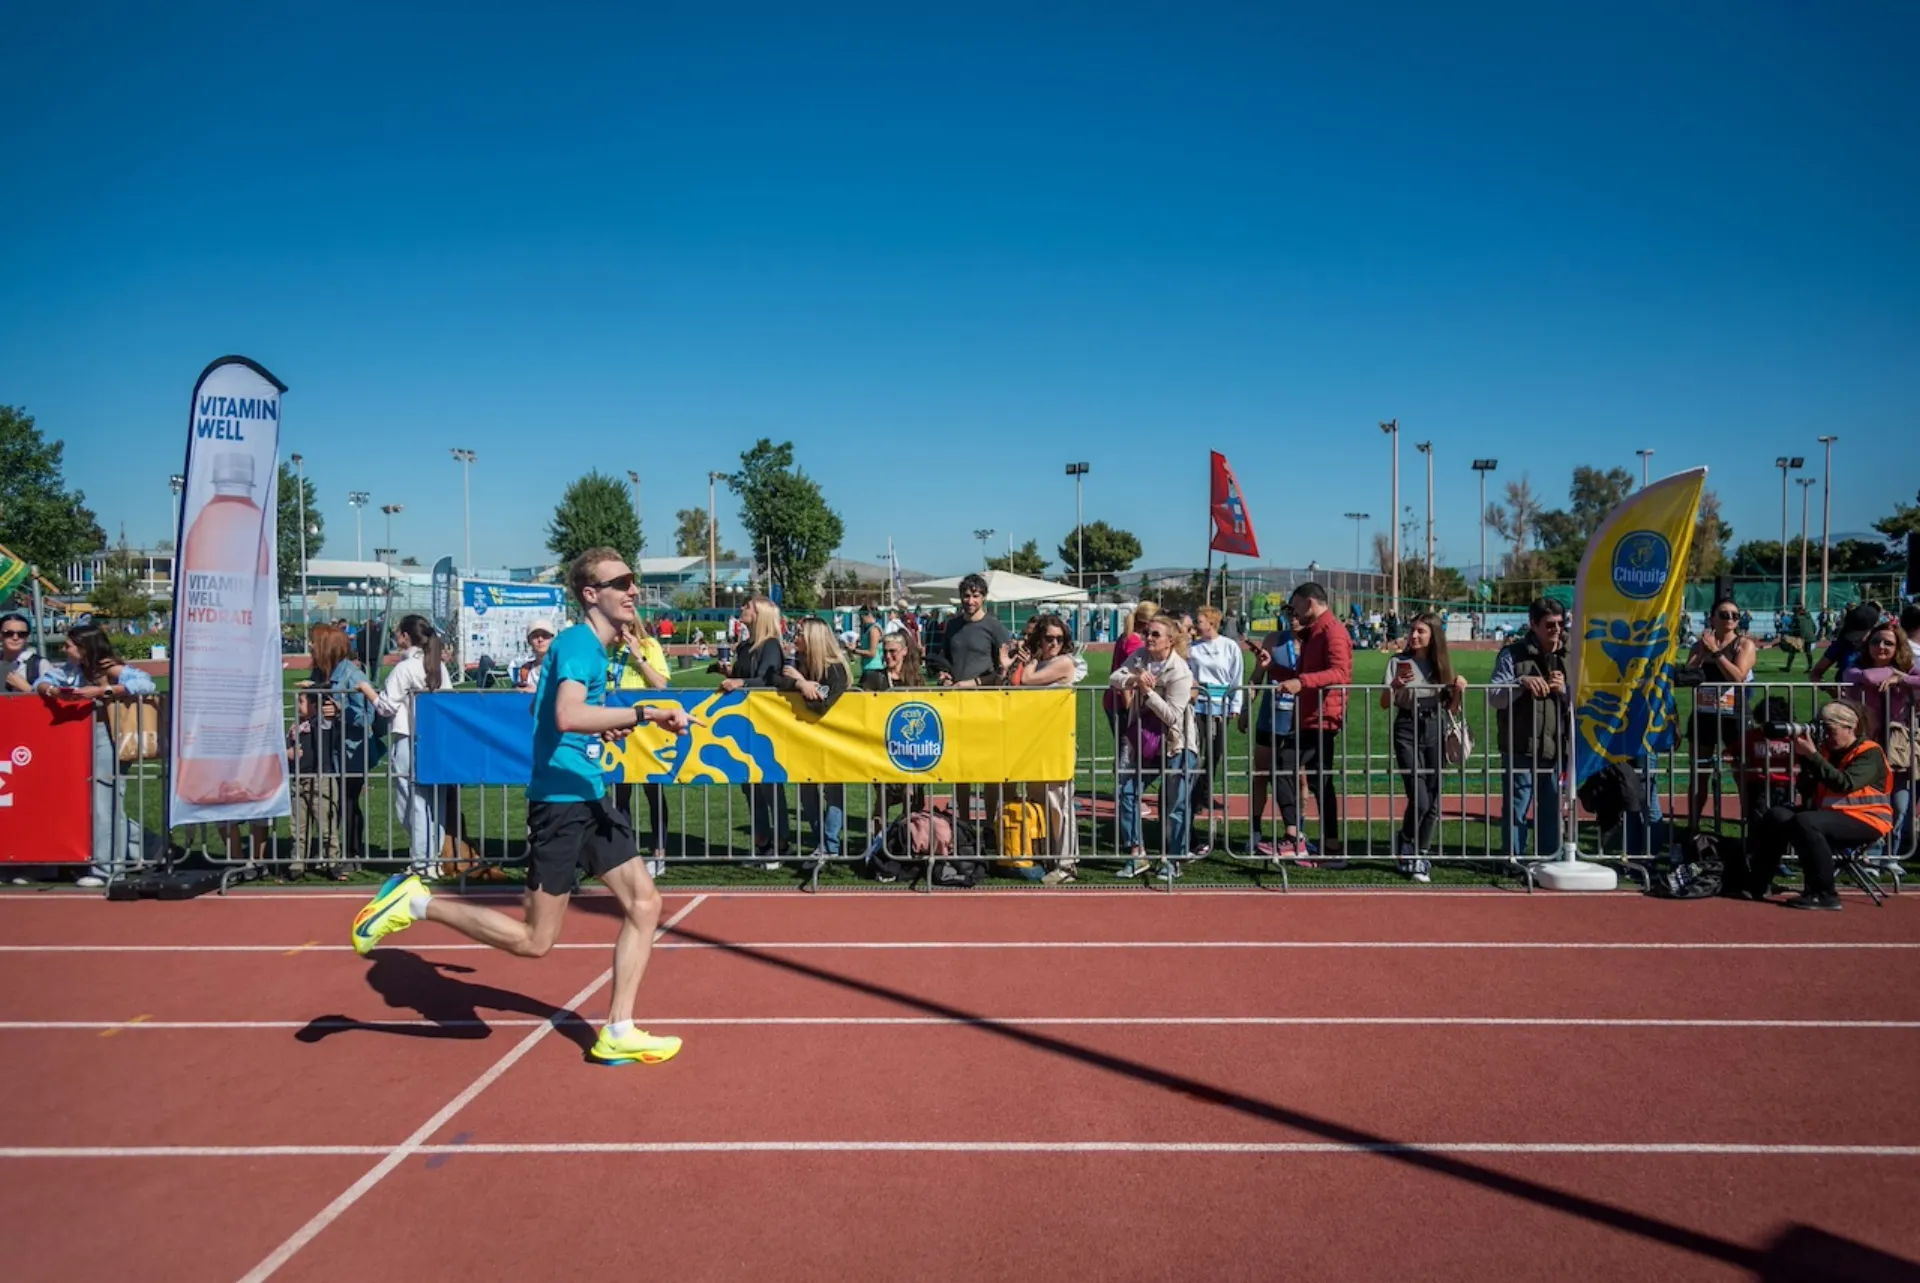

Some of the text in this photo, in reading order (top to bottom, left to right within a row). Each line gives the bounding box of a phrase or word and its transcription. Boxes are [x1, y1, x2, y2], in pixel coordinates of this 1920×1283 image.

[200, 395, 277, 420] VITAMIN
[197, 418, 244, 441] WELL
[1613, 566, 1666, 587] Chiquita
[188, 590, 224, 607] WELL
[187, 606, 253, 626] HYDRATE
[888, 740, 941, 761] Chiquita
